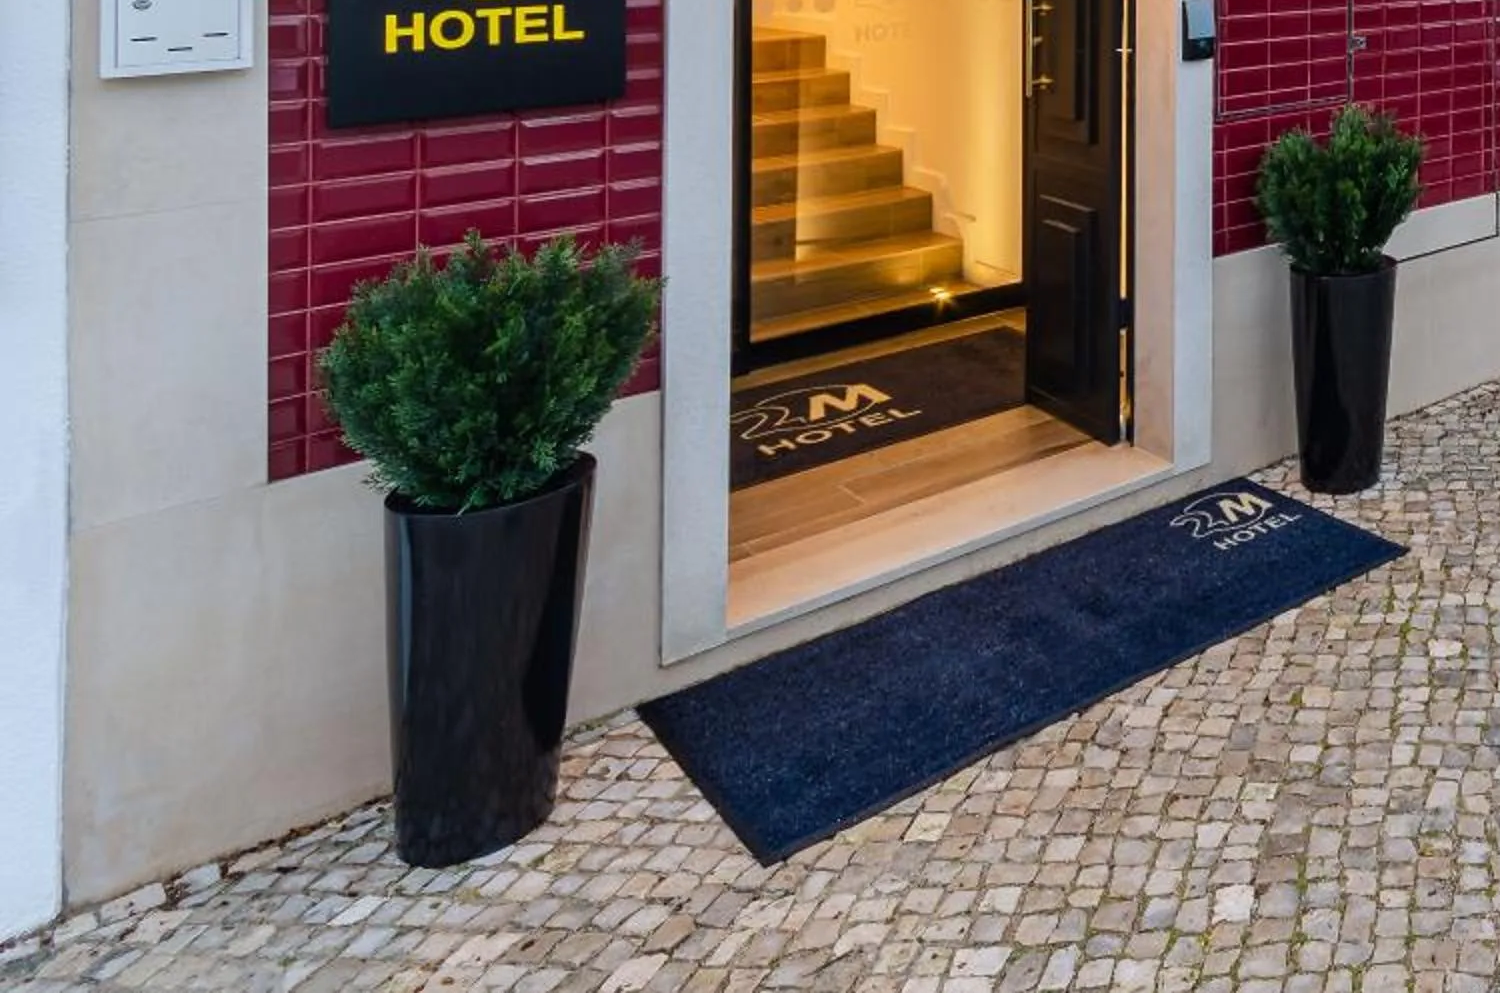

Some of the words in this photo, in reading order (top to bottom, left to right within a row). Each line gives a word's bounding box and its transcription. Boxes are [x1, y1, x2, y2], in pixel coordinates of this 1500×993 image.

[384, 5, 585, 53] HOTEL
[757, 407, 923, 456] HOTEL
[1170, 492, 1274, 538] 2M
[1213, 512, 1302, 550] HOTEL
